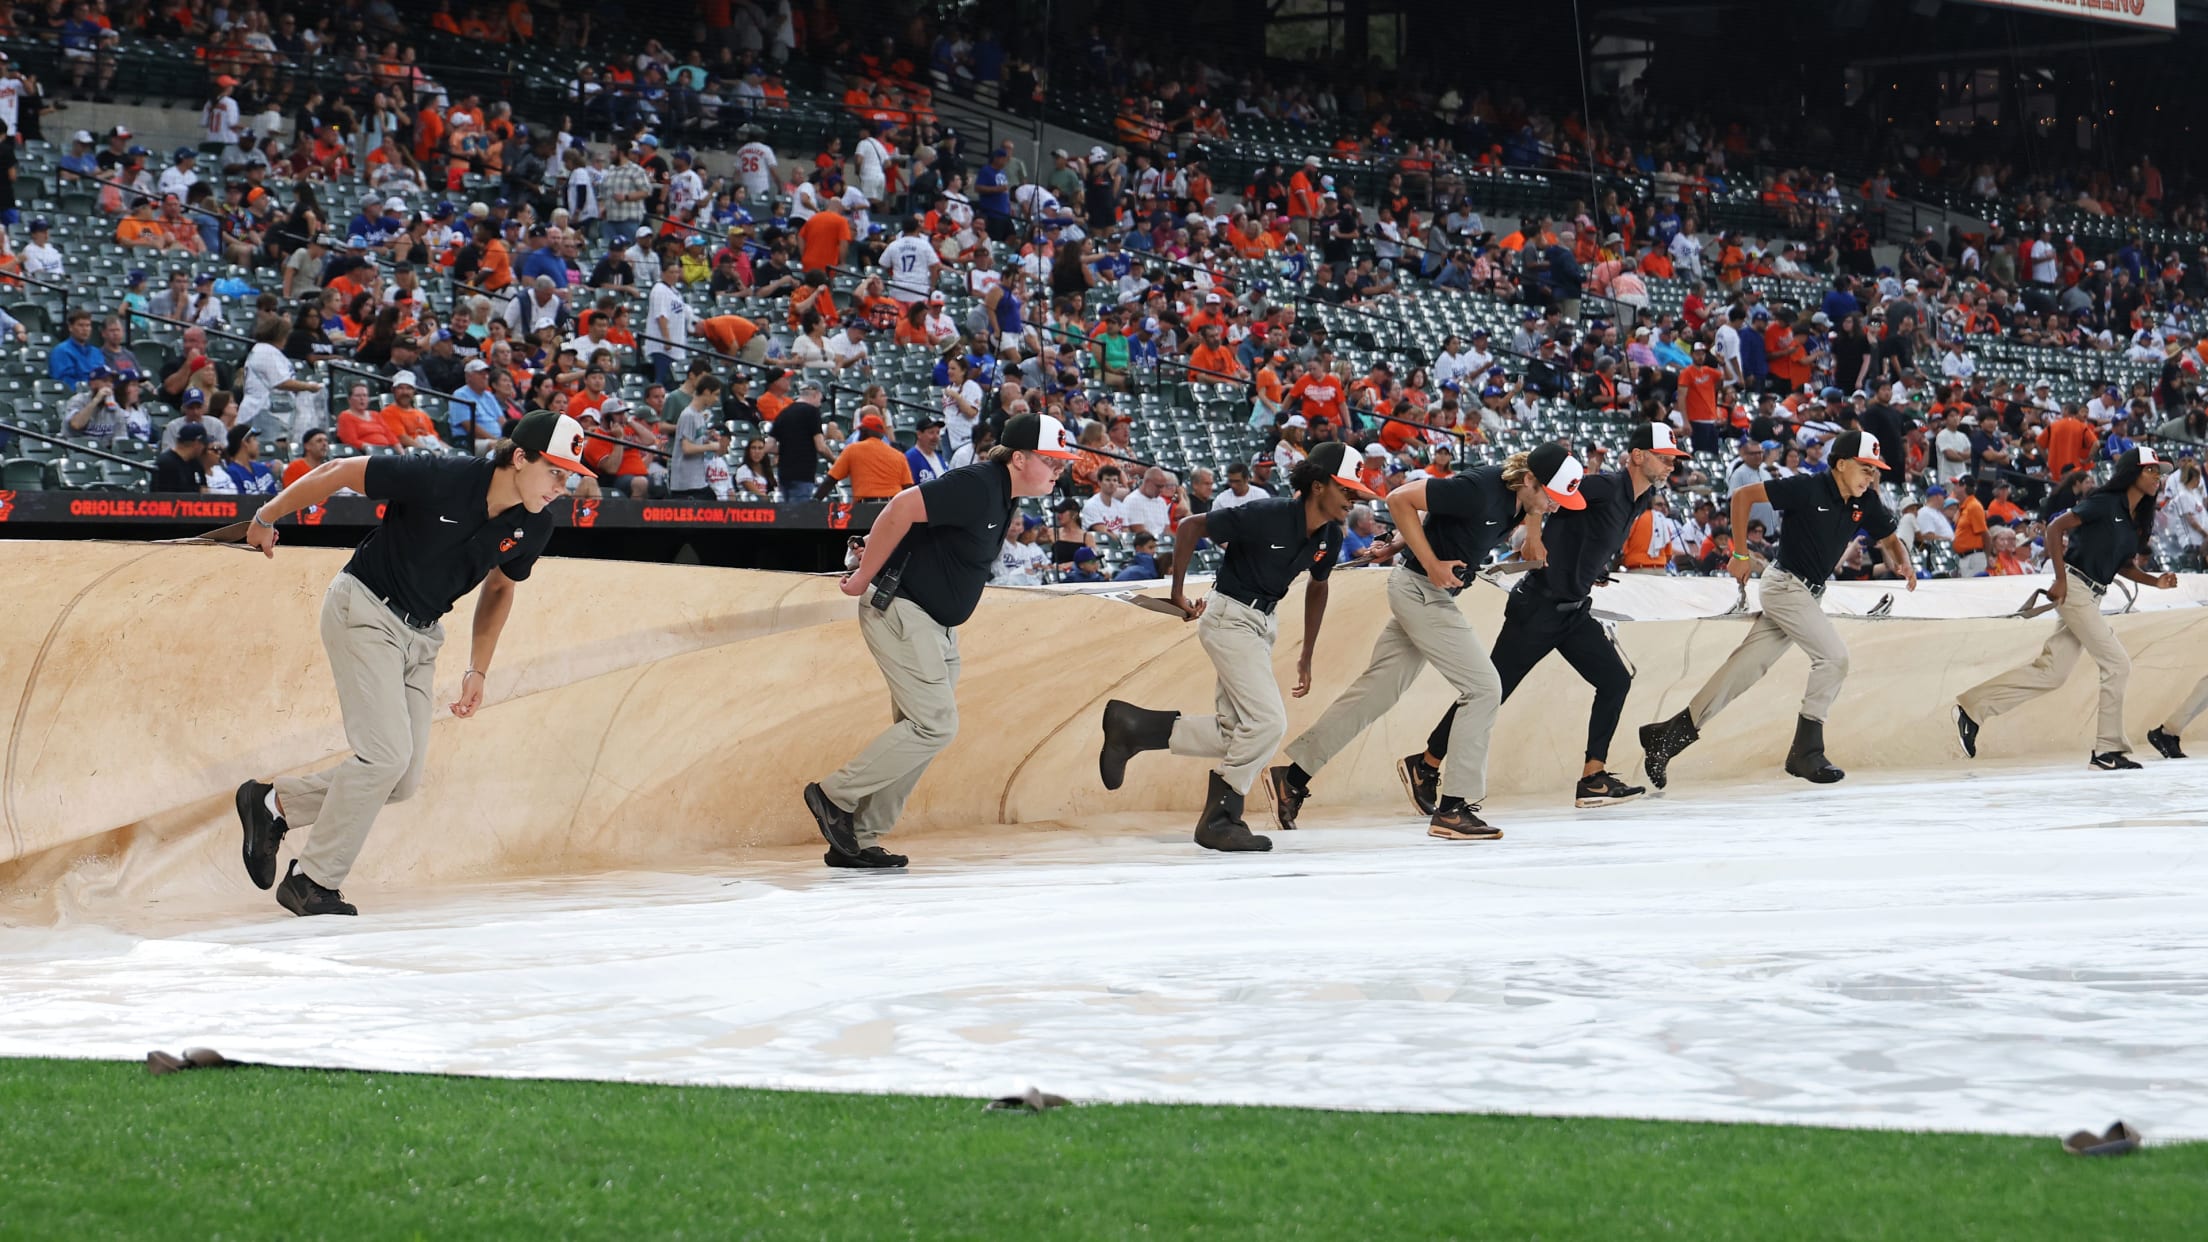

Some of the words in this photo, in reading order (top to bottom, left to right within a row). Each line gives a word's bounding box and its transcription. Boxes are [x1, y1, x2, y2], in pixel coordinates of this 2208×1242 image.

[742, 156, 759, 173] 26
[901, 254, 916, 273] 17
[70, 499, 238, 518] ORIOLES.COM/TICKETS
[643, 506, 776, 523] ORIOLES.COM/TICKETS
